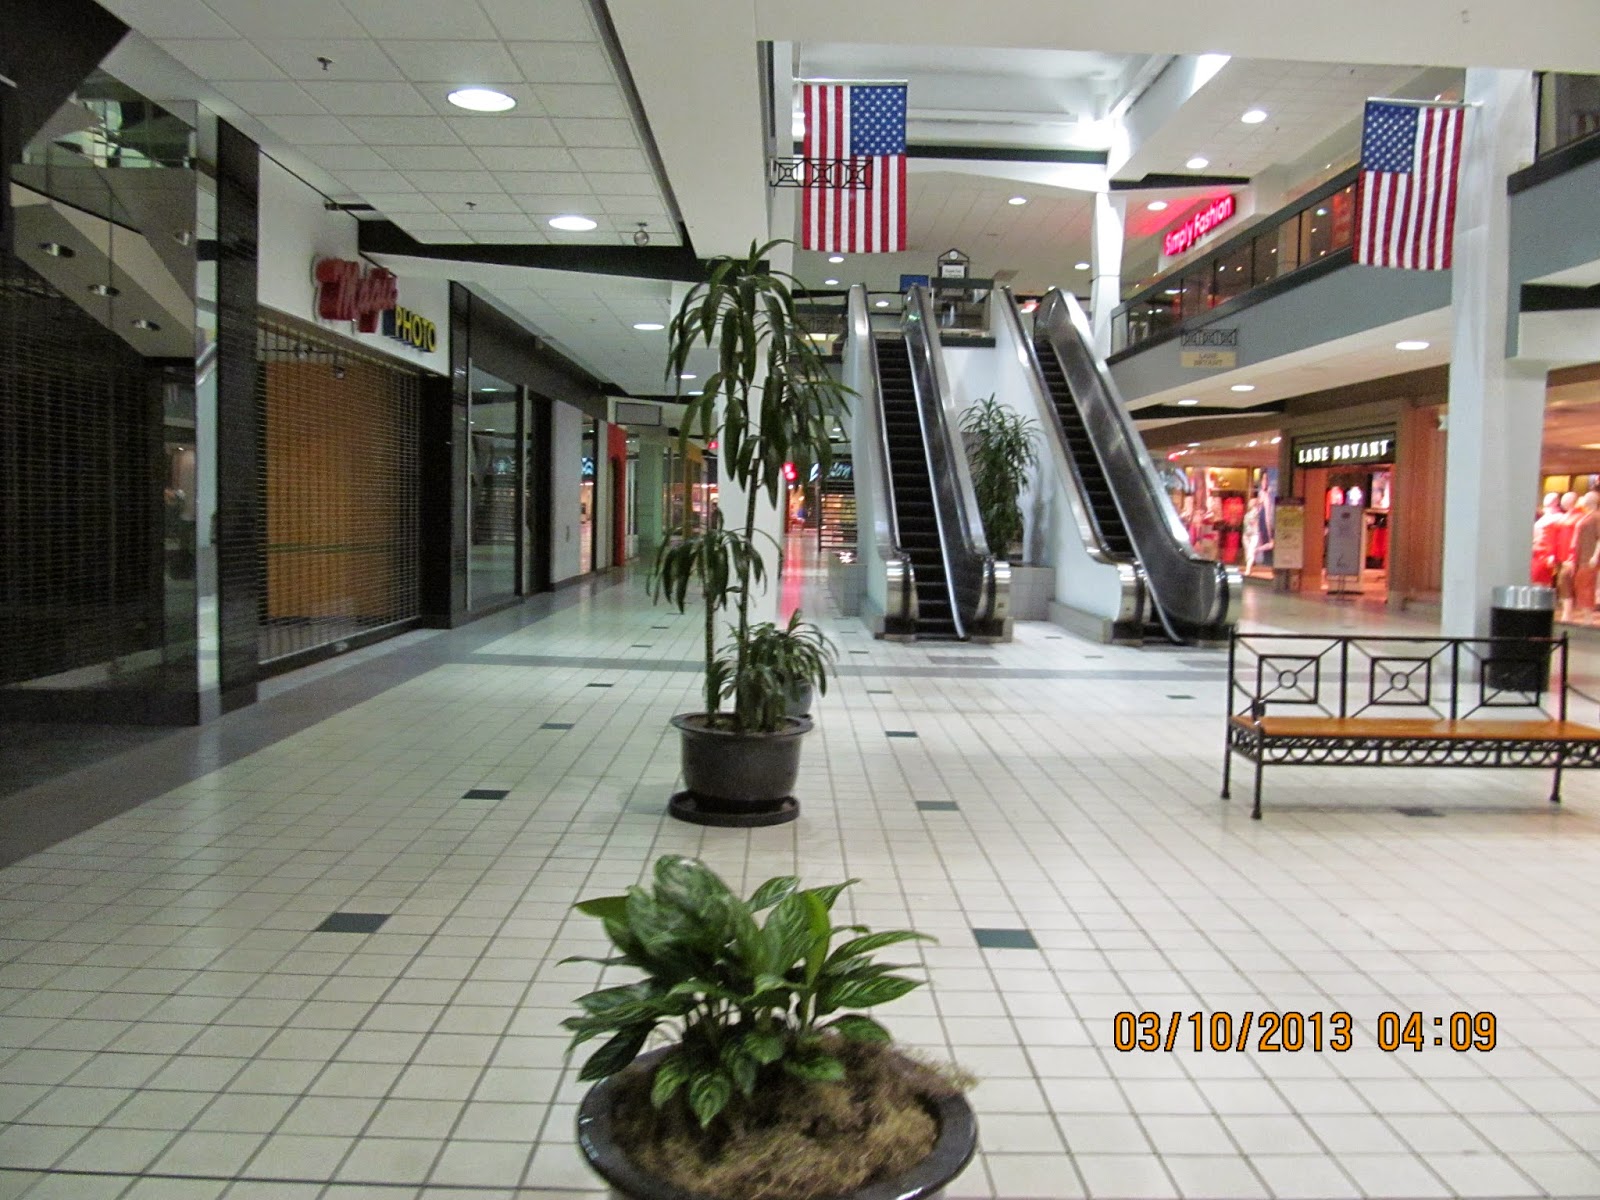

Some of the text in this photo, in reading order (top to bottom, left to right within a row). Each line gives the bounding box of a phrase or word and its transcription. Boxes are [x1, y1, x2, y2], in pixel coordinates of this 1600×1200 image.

[1164, 195, 1233, 256] Simply Fashion
[394, 304, 437, 353] PHOTO
[1298, 439, 1390, 464] LANE BRYANT
